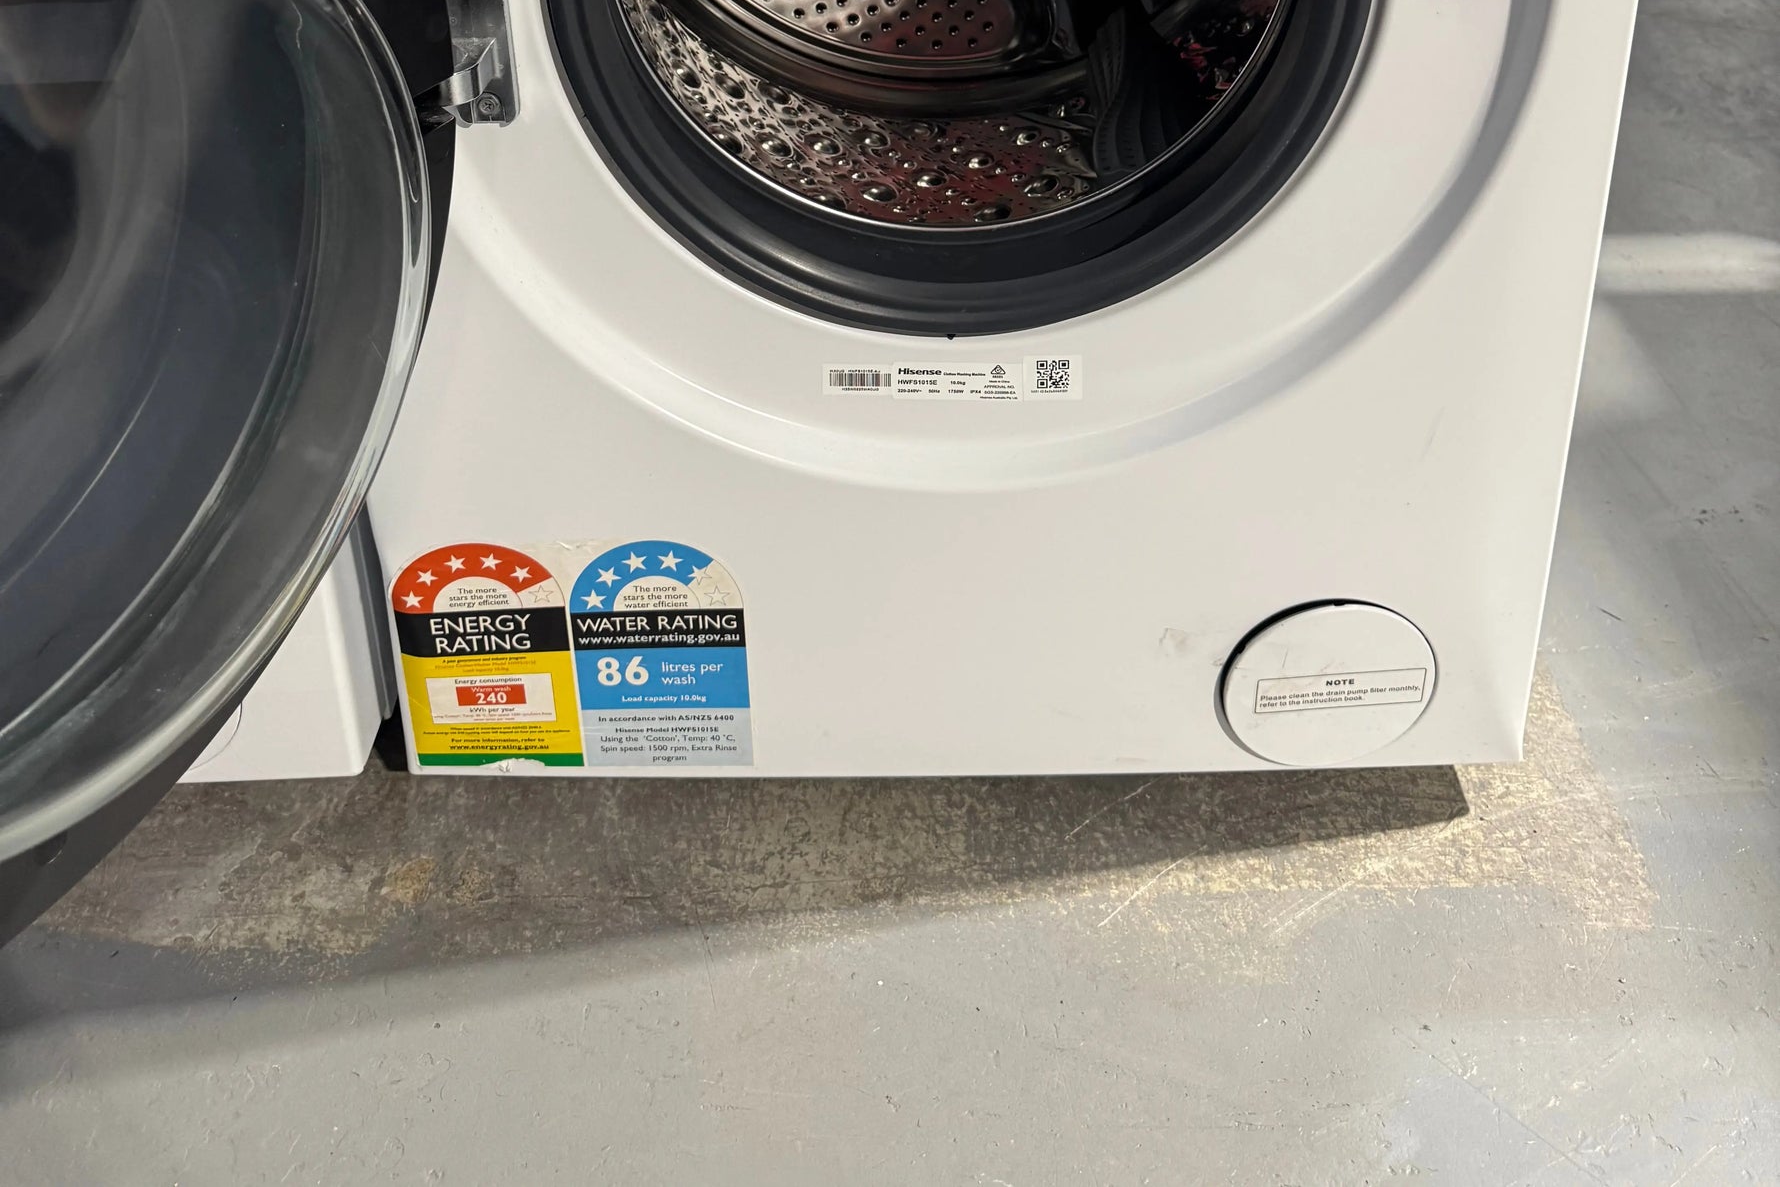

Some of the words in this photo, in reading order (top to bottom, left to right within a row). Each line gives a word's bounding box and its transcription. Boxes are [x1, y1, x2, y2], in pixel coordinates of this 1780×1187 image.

[633, 585, 651, 593] The
[449, 600, 476, 608] energy
[653, 600, 688, 608] efficient
[429, 614, 531, 636] ENERGY
[576, 616, 650, 633] WATER
[658, 615, 737, 630] RATING
[435, 633, 531, 654] RATING
[578, 633, 740, 645] www.waterrating.gov.au
[596, 655, 650, 686] 86
[662, 662, 695, 672] litres
[701, 663, 723, 674] per
[662, 675, 696, 685] wash
[476, 692, 507, 704] 240
[644, 695, 677, 703] capacity
[600, 735, 623, 743] Using
[683, 735, 707, 743] Temp:
[600, 745, 617, 753] Spin
[620, 745, 646, 753] speed:
[652, 754, 687, 762] program
